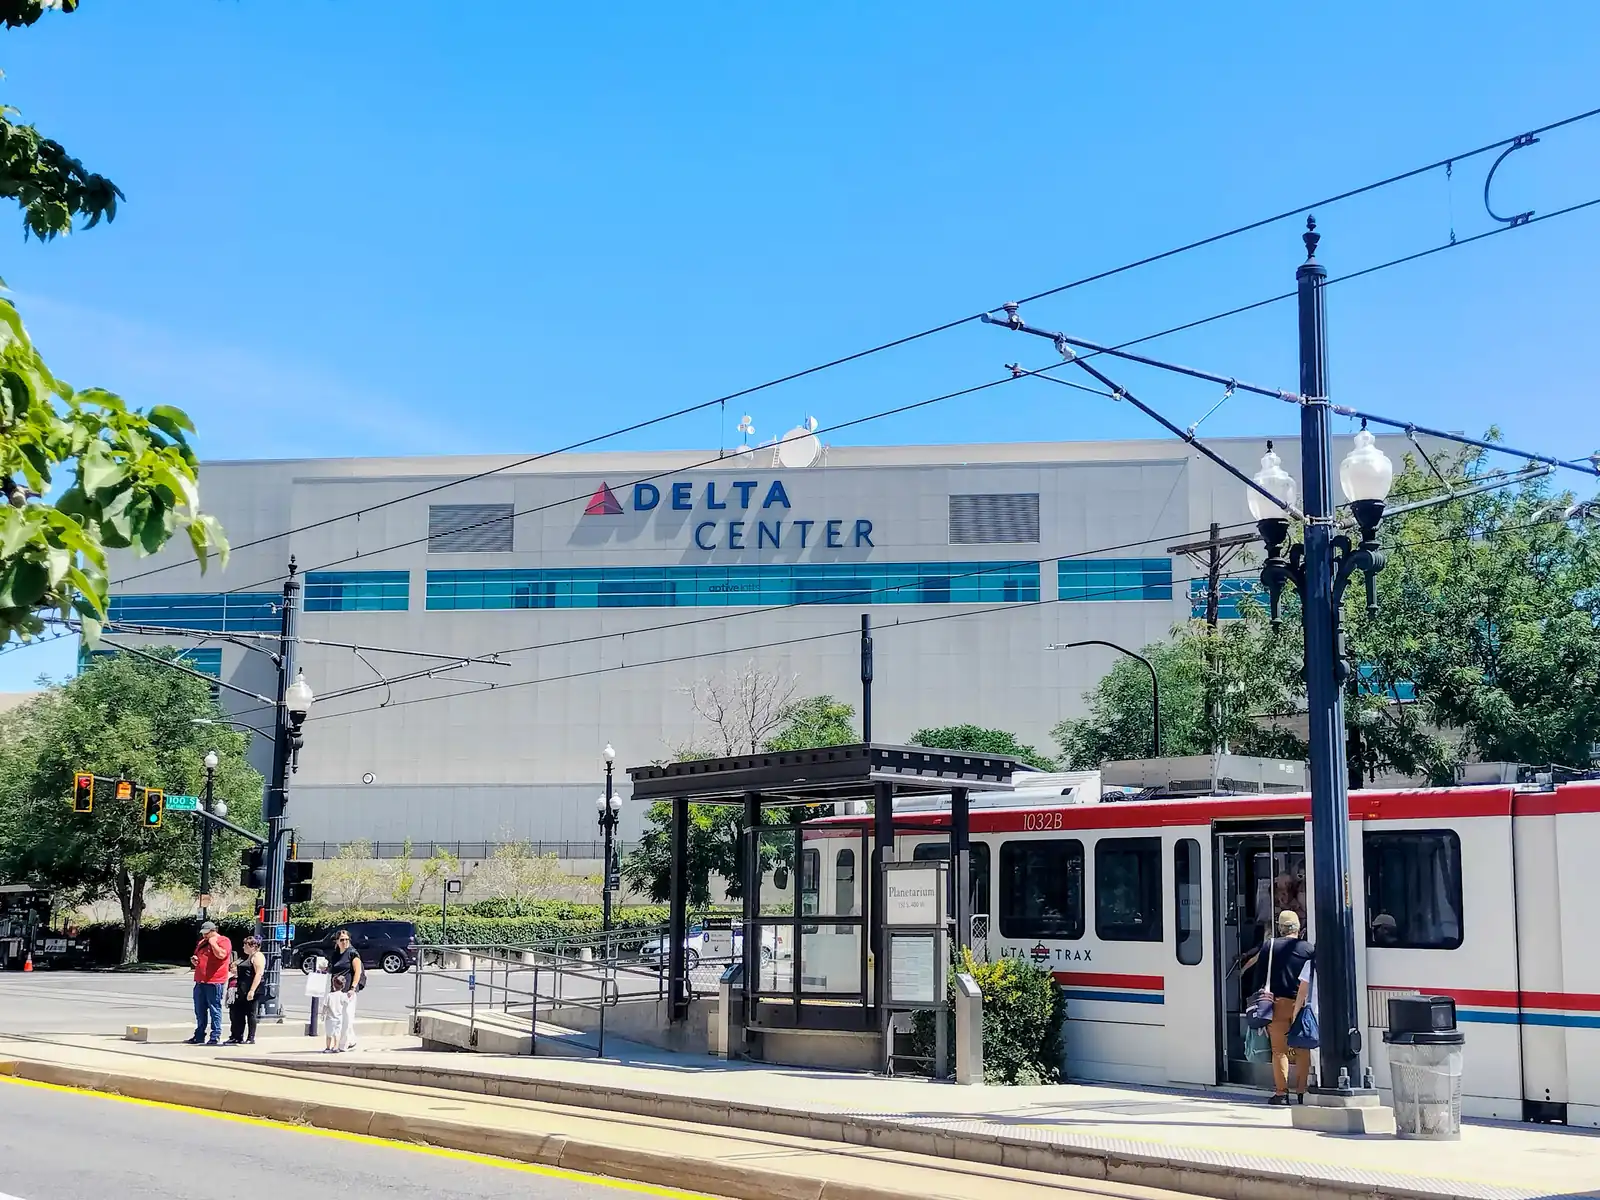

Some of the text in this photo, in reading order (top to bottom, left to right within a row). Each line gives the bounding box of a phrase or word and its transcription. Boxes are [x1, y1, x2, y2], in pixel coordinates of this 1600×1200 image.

[633, 480, 791, 511] DELTA
[695, 519, 875, 550] CENTER
[169, 797, 186, 805] 100
[1023, 812, 1063, 831] 1032B
[888, 886, 935, 898] Planetarium
[1000, 947, 1092, 961] UTA TRAX
